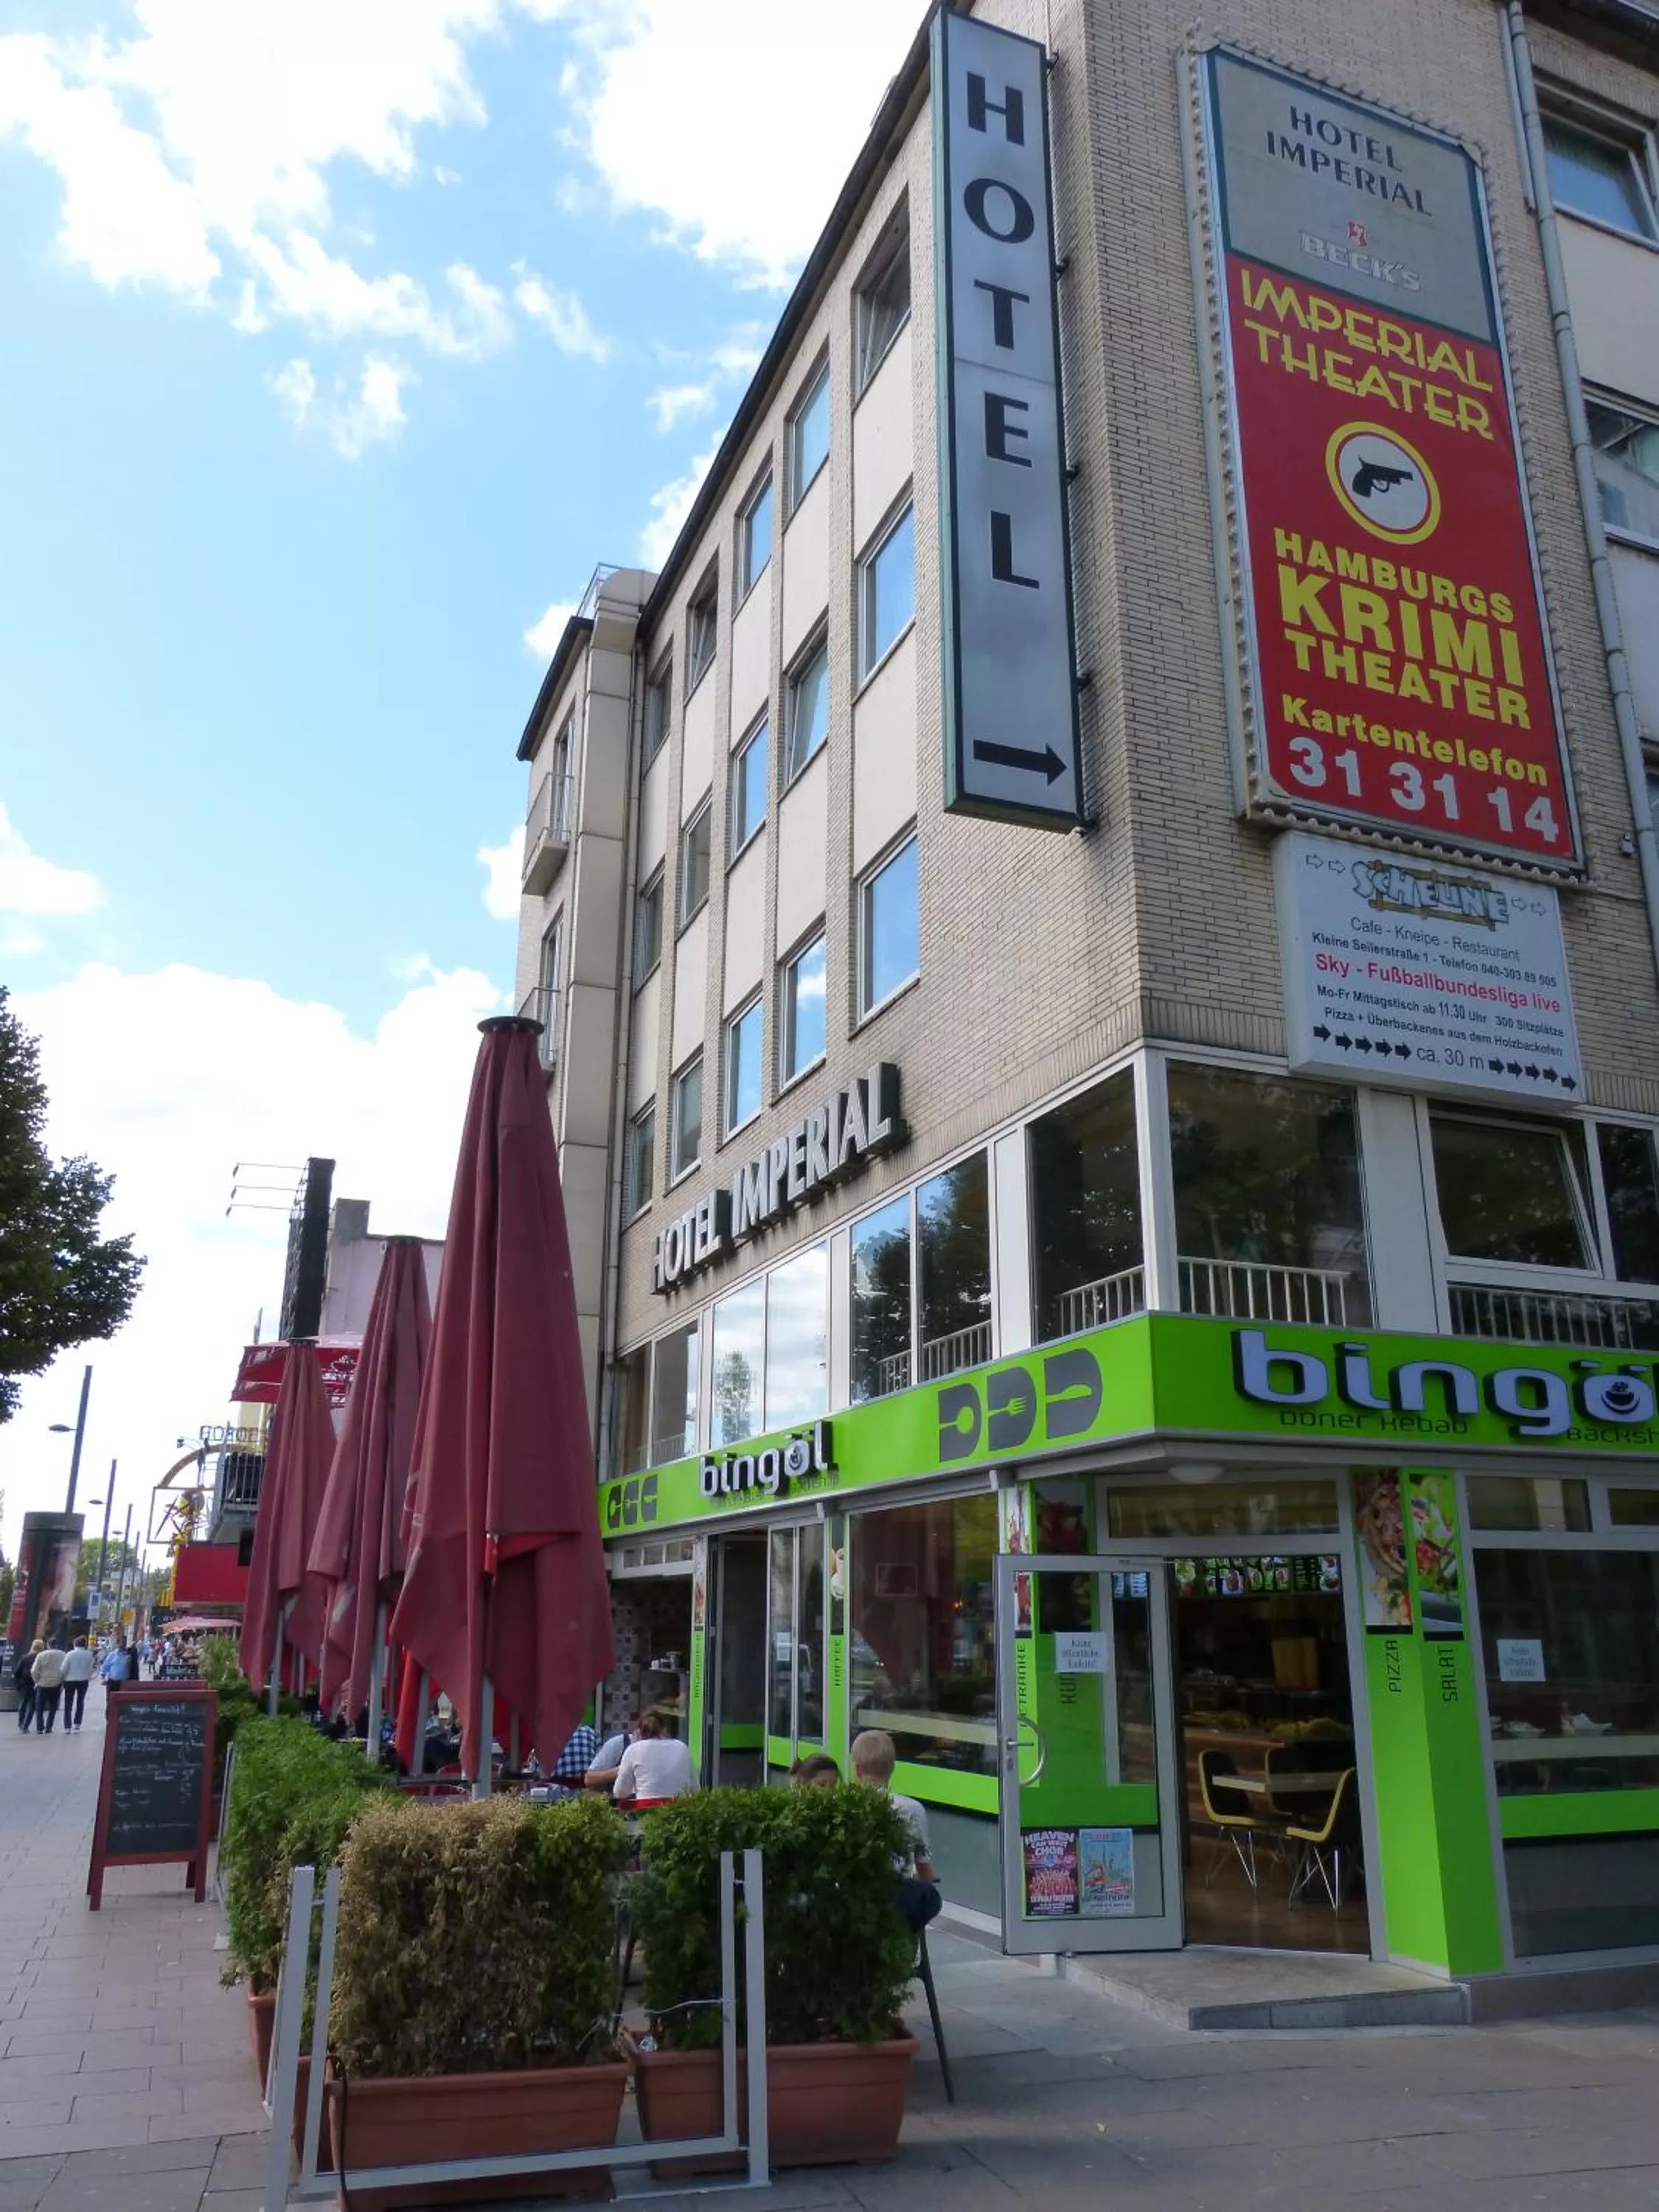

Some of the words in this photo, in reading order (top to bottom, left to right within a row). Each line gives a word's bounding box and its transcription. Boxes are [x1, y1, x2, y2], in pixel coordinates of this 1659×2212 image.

[1265, 130, 1433, 218] IMPERIAL
[1290, 105, 1404, 173] HOTEL
[1298, 229, 1422, 293] BECK'S
[962, 72, 1040, 589] HOTEL
[1241, 268, 1492, 392] IMPERIAL
[1244, 318, 1495, 440] THEATER
[1273, 526, 1515, 624] HAMBURGS
[1277, 563, 1525, 688] KRIMI
[1284, 628, 1531, 731] THEATER
[1280, 694, 1548, 787] Kartentelefon
[1289, 737, 1363, 798] 31
[1389, 762, 1460, 821] 31
[1486, 786, 1560, 844] 14
[1351, 860, 1510, 925] SCHEUNE
[1311, 931, 1350, 950] Kleine
[1439, 955, 1479, 973] Telefon
[1315, 953, 1350, 979] Sky
[1367, 961, 1528, 1009] Fußballbundesliga
[1531, 992, 1562, 1013] live
[1394, 925, 1441, 947] Kneipe
[1451, 936, 1521, 962] Restaurant
[1316, 984, 1351, 1001] Mo-Fr
[1352, 989, 1420, 1012] Mittagstisch
[1422, 1003, 1436, 1015] ab
[1467, 1009, 1488, 1025] Uhr
[1495, 1015, 1514, 1029] 300
[1324, 1006, 1355, 1022] Pizza
[1447, 1028, 1467, 1041] aus
[1469, 1031, 1492, 1046] dem
[1493, 1034, 1564, 1058] Holzbackofen
[1416, 1047, 1441, 1064] ca.
[1444, 1046, 1465, 1068] 30
[1469, 1054, 1485, 1071] m
[652, 1190, 728, 1295] HOTEL
[731, 1062, 897, 1239] IMPERIAL
[1231, 1329, 1659, 1439] bingö
[699, 1419, 833, 1498] bingöl
[1385, 1639, 1402, 1693] PIZZA
[1437, 1645, 1458, 1702] SALAT
